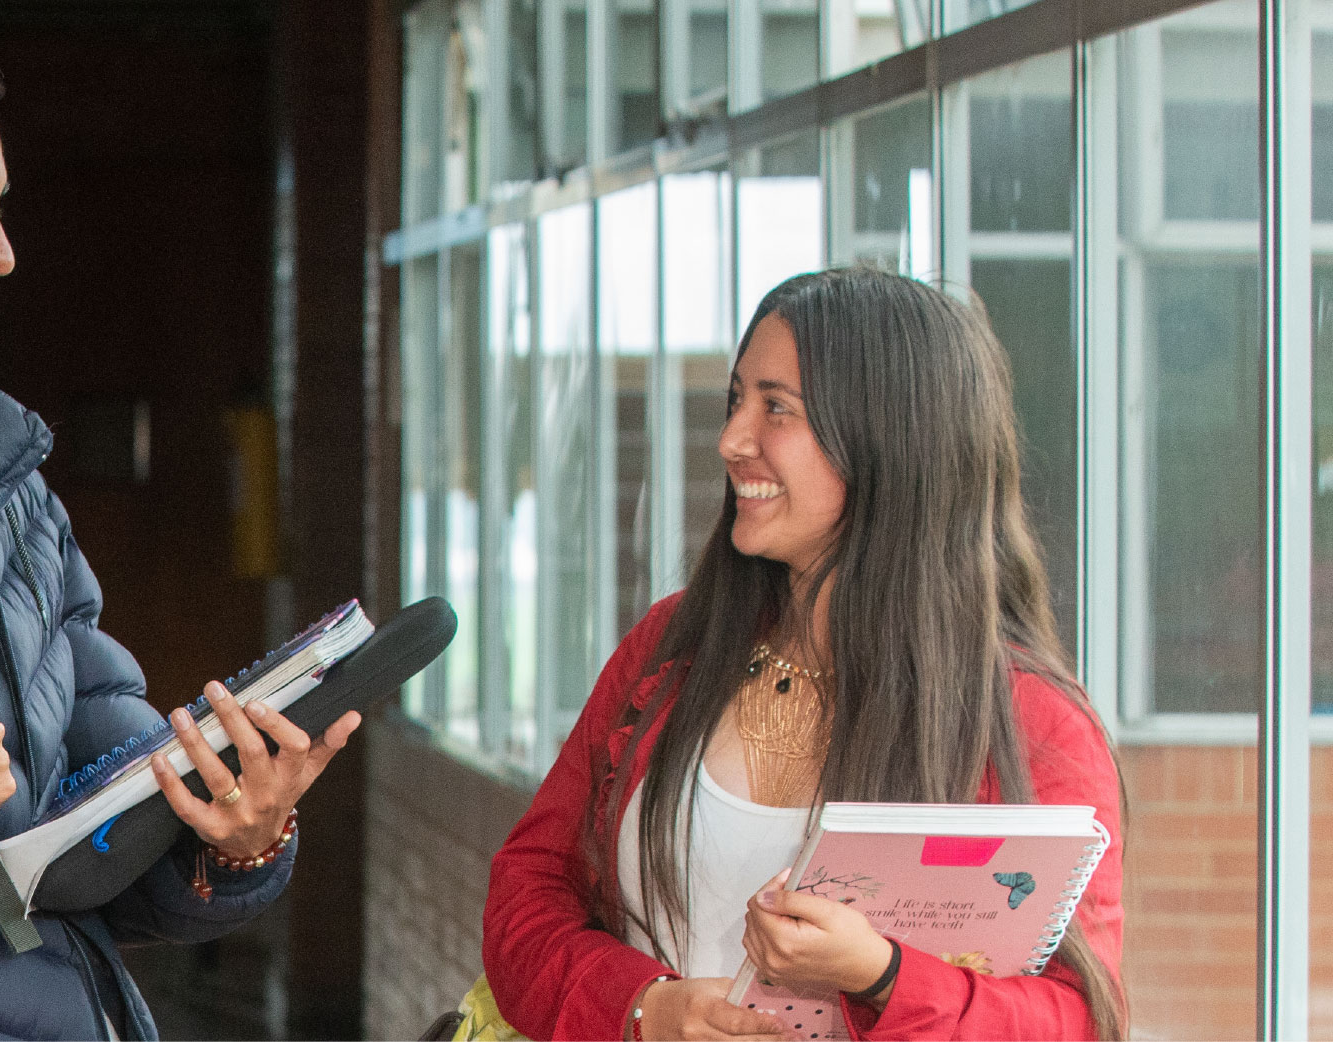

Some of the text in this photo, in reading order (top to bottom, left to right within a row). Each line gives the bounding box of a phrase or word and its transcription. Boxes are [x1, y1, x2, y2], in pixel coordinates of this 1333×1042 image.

[894, 898, 920, 909] Life
[924, 900, 935, 909] is
[865, 909, 999, 920] smile while you still
[894, 918, 964, 930] have teeth
